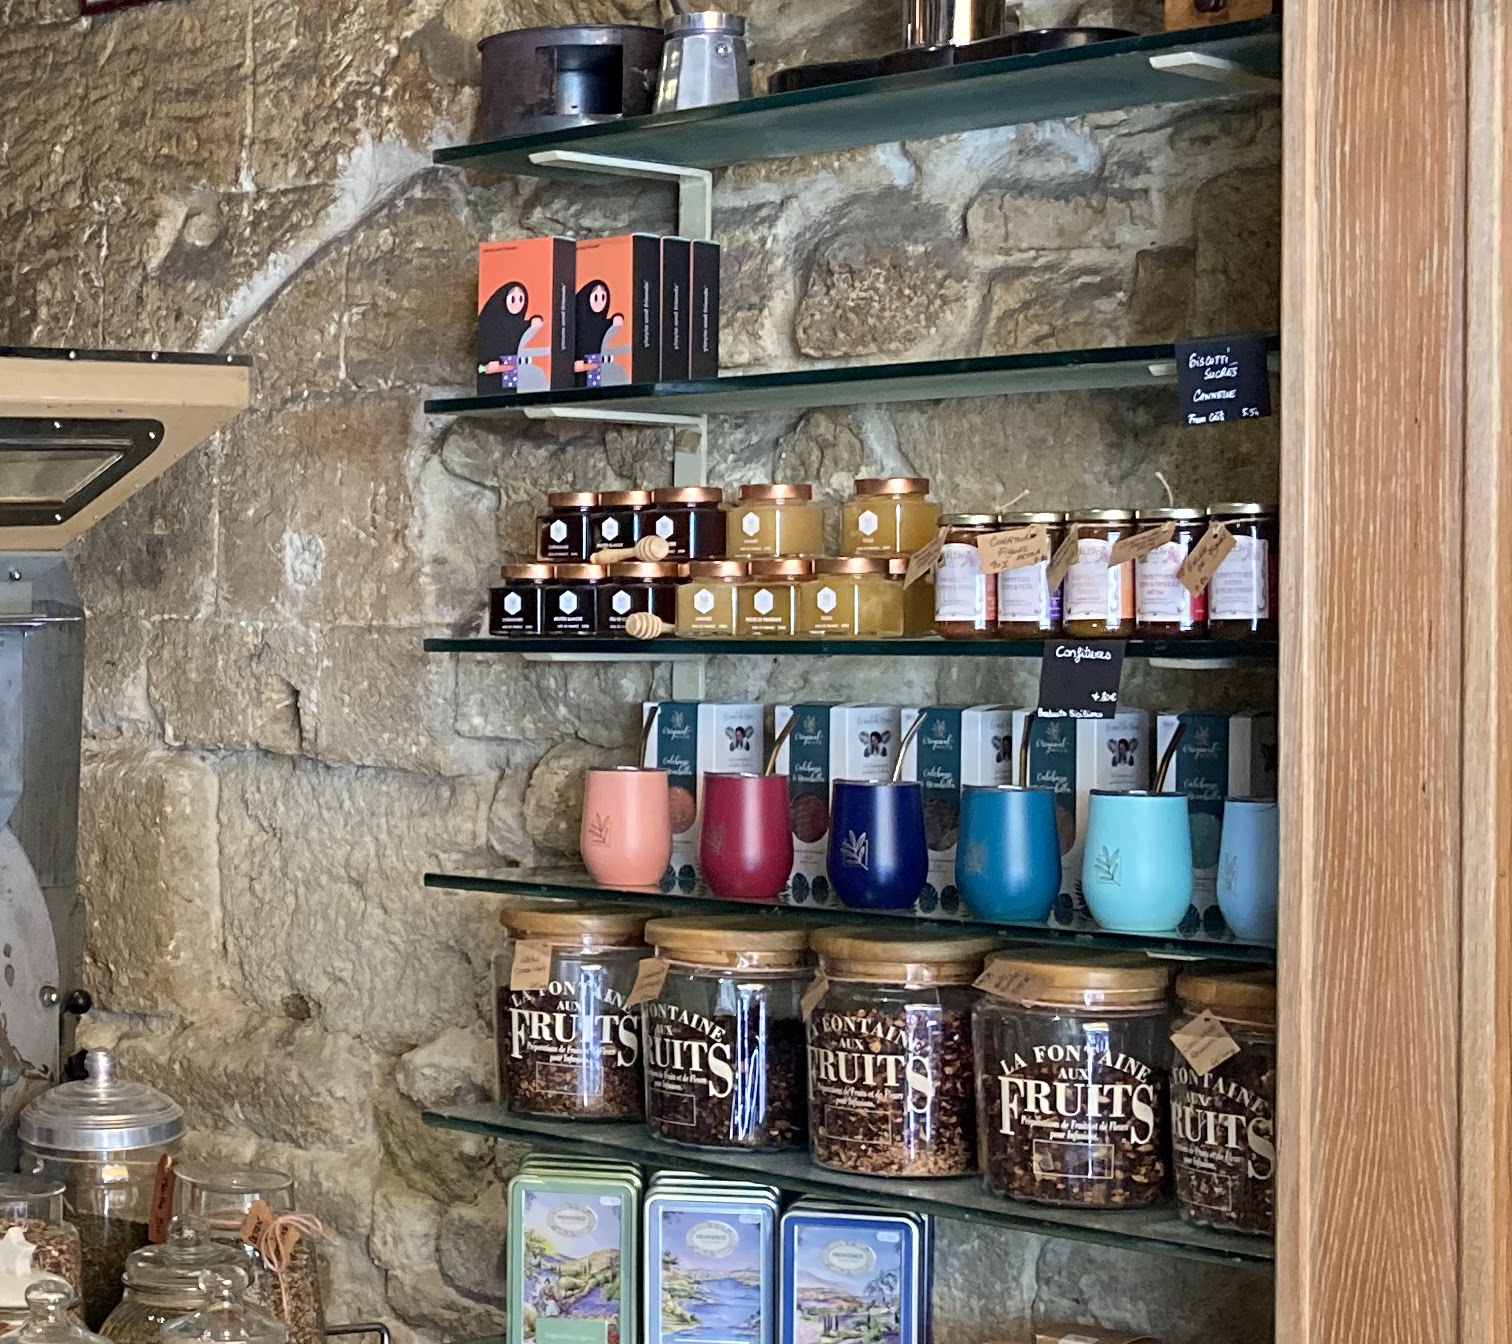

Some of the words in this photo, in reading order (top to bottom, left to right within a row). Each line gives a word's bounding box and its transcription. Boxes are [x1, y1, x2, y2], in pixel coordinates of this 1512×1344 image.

[509, 1007, 638, 1067] FRUITS
[644, 1003, 726, 1042] ONTAINE
[838, 1037, 864, 1050] AUX
[646, 1036, 733, 1098] RUITS
[807, 1044, 935, 1113] FRUITS
[1000, 1053, 1028, 1075] LA
[1032, 1044, 1152, 1083] FONTAINE
[1058, 1068, 1088, 1080] AUX
[997, 1076, 1154, 1145] FRUITS
[1172, 1101, 1275, 1180] RUITS
